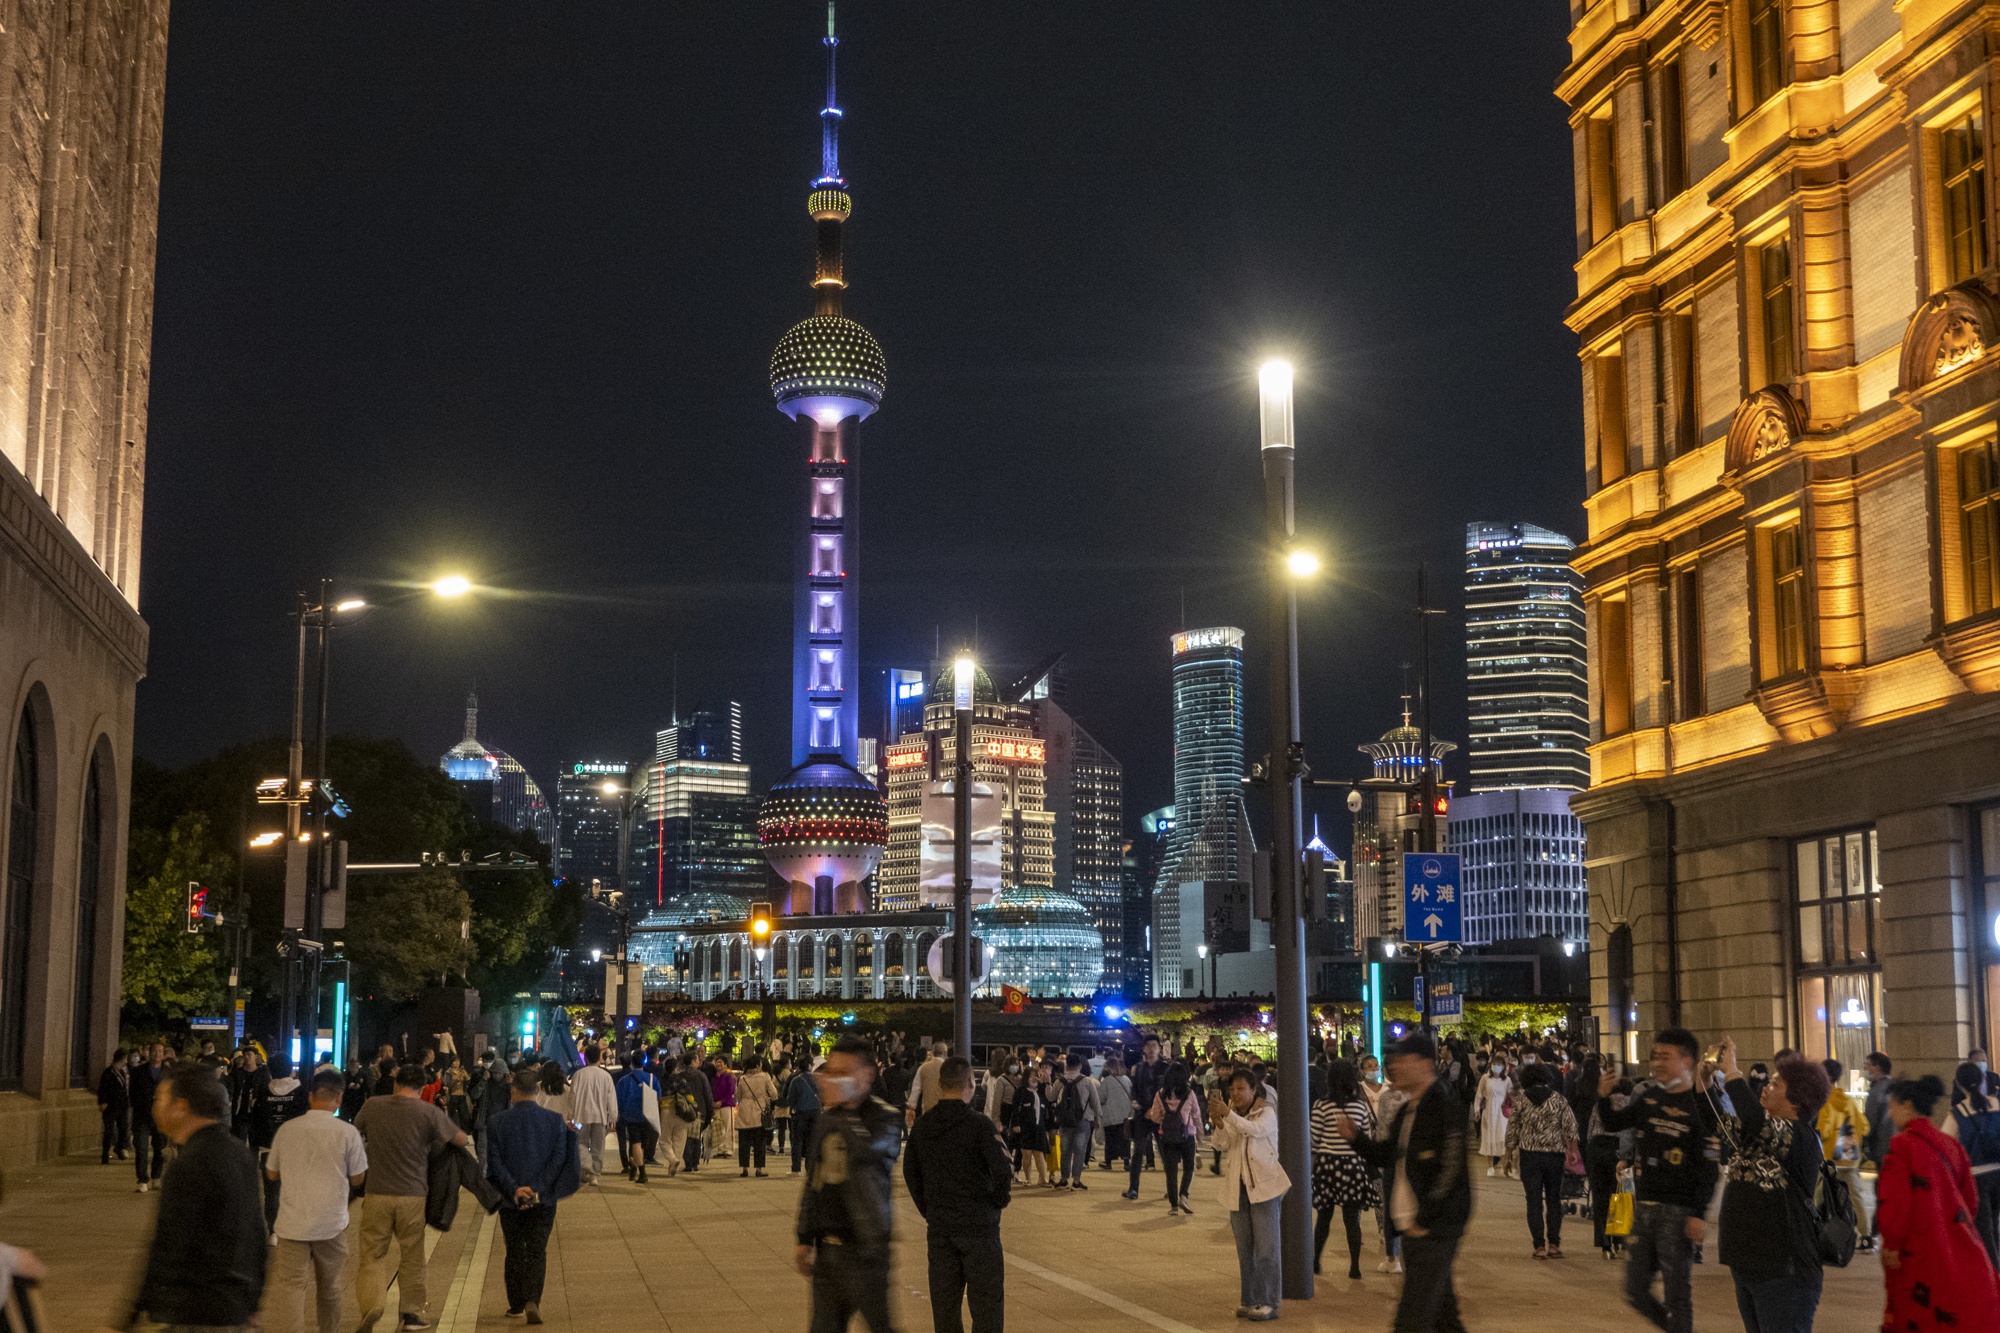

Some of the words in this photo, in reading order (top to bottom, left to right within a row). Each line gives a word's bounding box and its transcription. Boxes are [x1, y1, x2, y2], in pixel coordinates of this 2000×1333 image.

[987, 741, 1045, 760] 中国平安
[889, 752, 923, 766] 中国平安
[584, 764, 627, 772] 中国农业银行
[1411, 883, 1456, 904] 外滩
[1436, 1000, 1455, 1012] 南京东路
